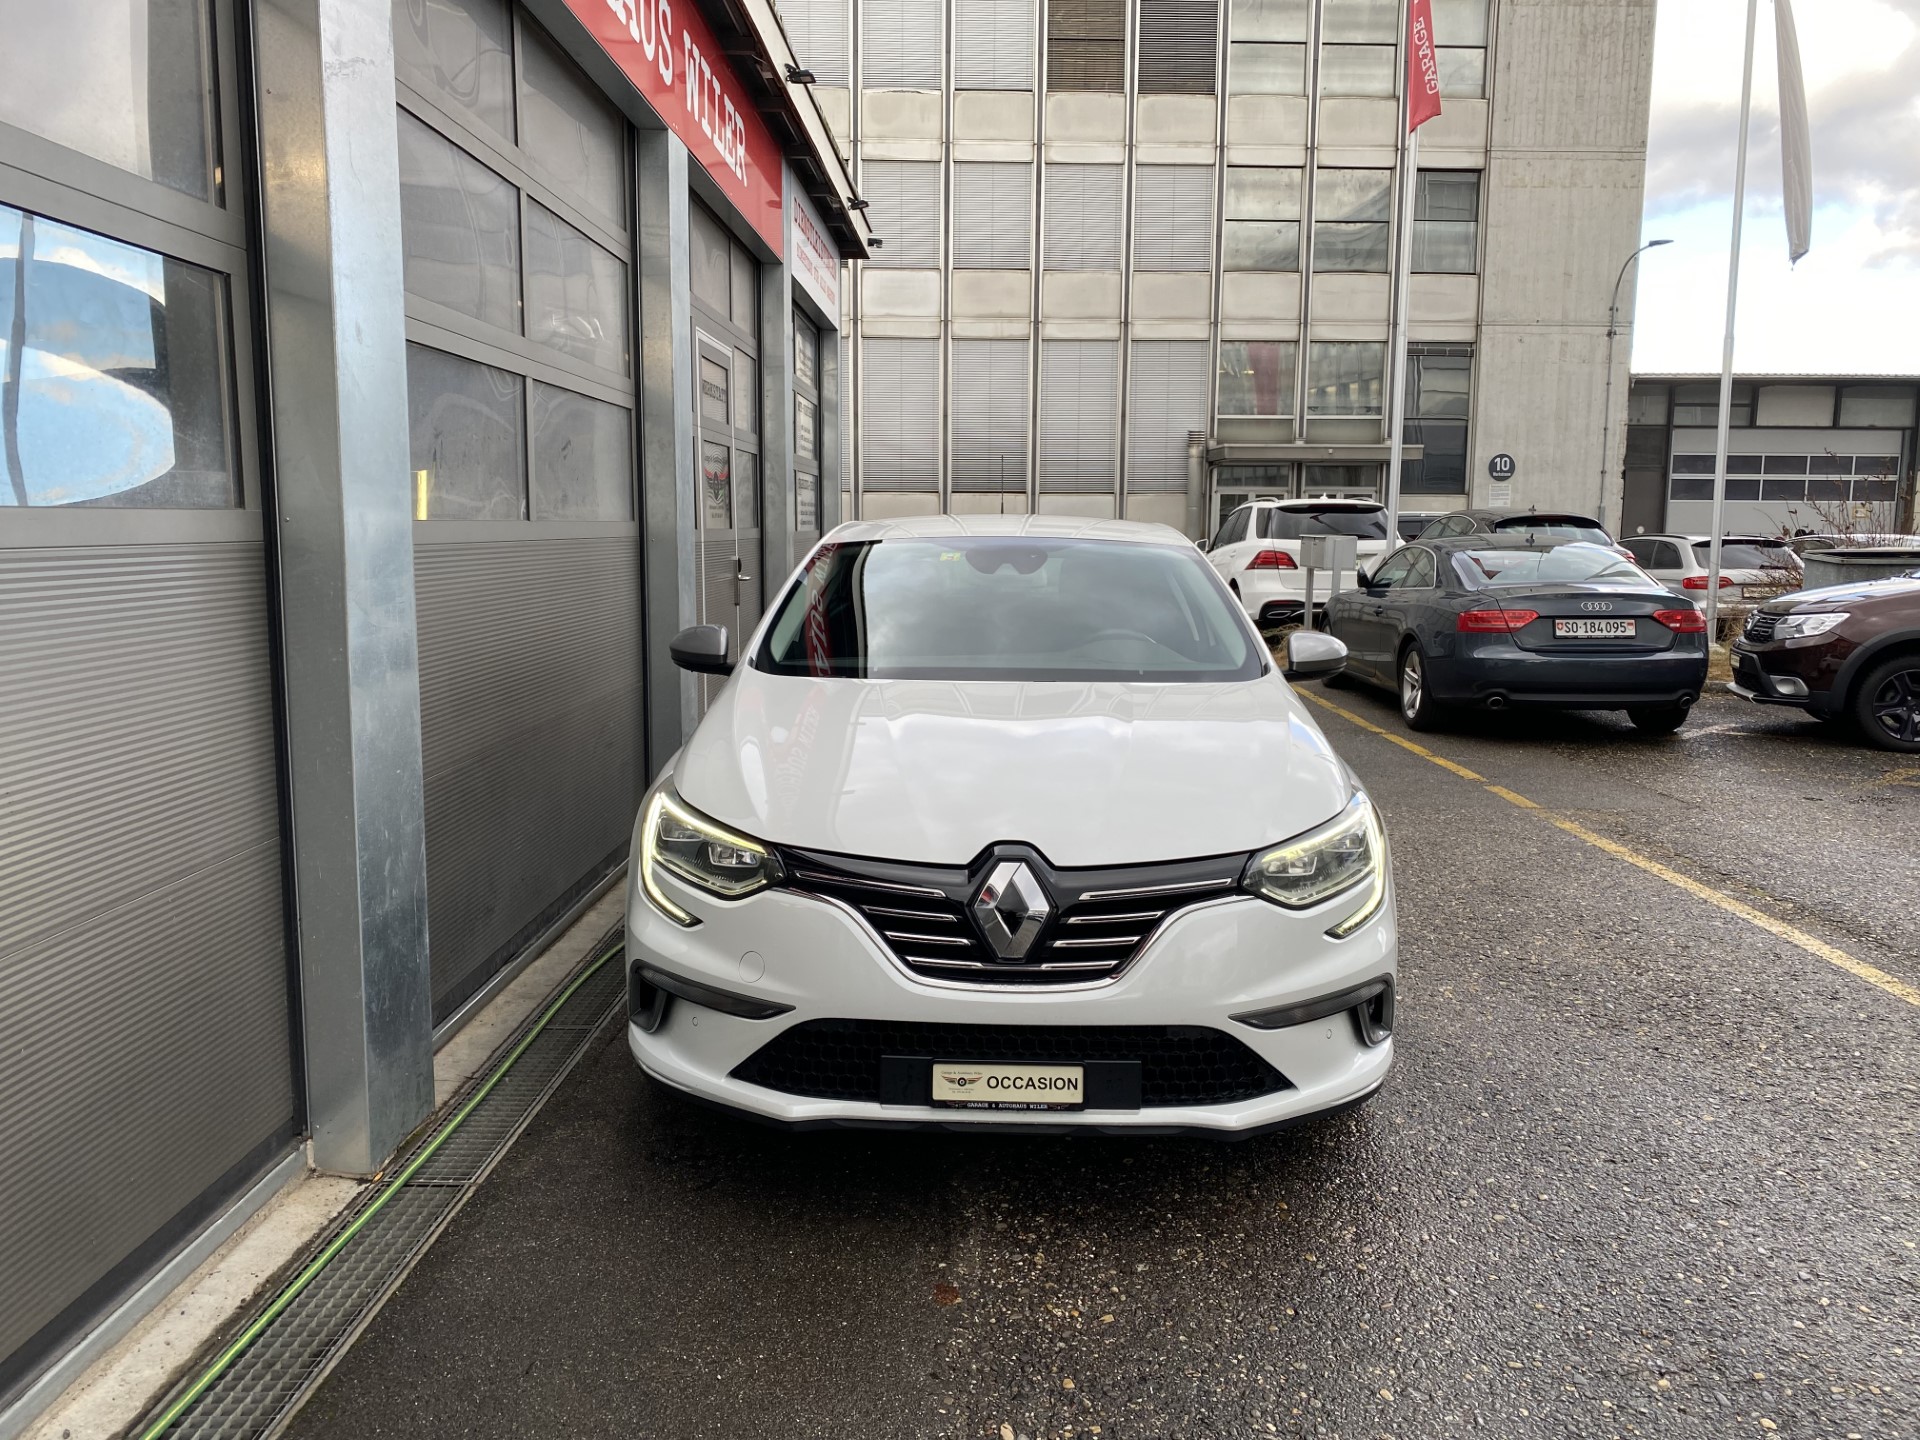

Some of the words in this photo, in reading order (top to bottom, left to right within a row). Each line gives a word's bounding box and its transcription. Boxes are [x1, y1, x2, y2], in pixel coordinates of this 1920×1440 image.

[1414, 17, 1439, 94] GARAGE
[683, 29, 747, 187] WILER
[1494, 457, 1510, 471] 10
[987, 1076, 1078, 1090] OCCASION
